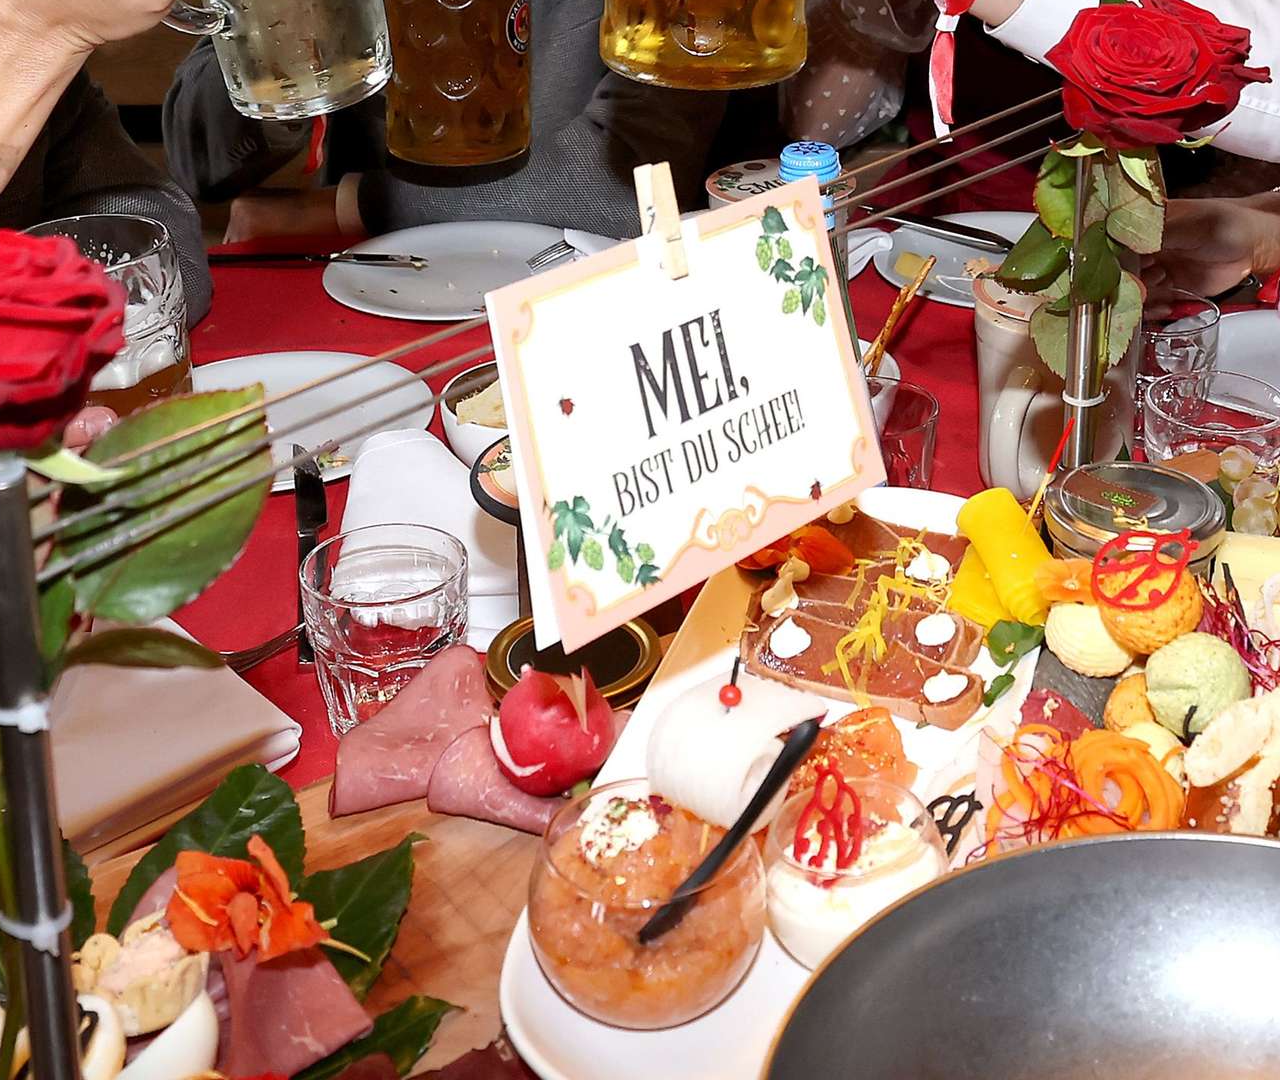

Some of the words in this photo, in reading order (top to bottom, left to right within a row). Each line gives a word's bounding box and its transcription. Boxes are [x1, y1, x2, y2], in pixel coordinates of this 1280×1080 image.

[629, 308, 750, 439] MEI,
[612, 448, 674, 517] BIST
[681, 429, 719, 484] DU
[722, 388, 806, 463] SCHEE!
